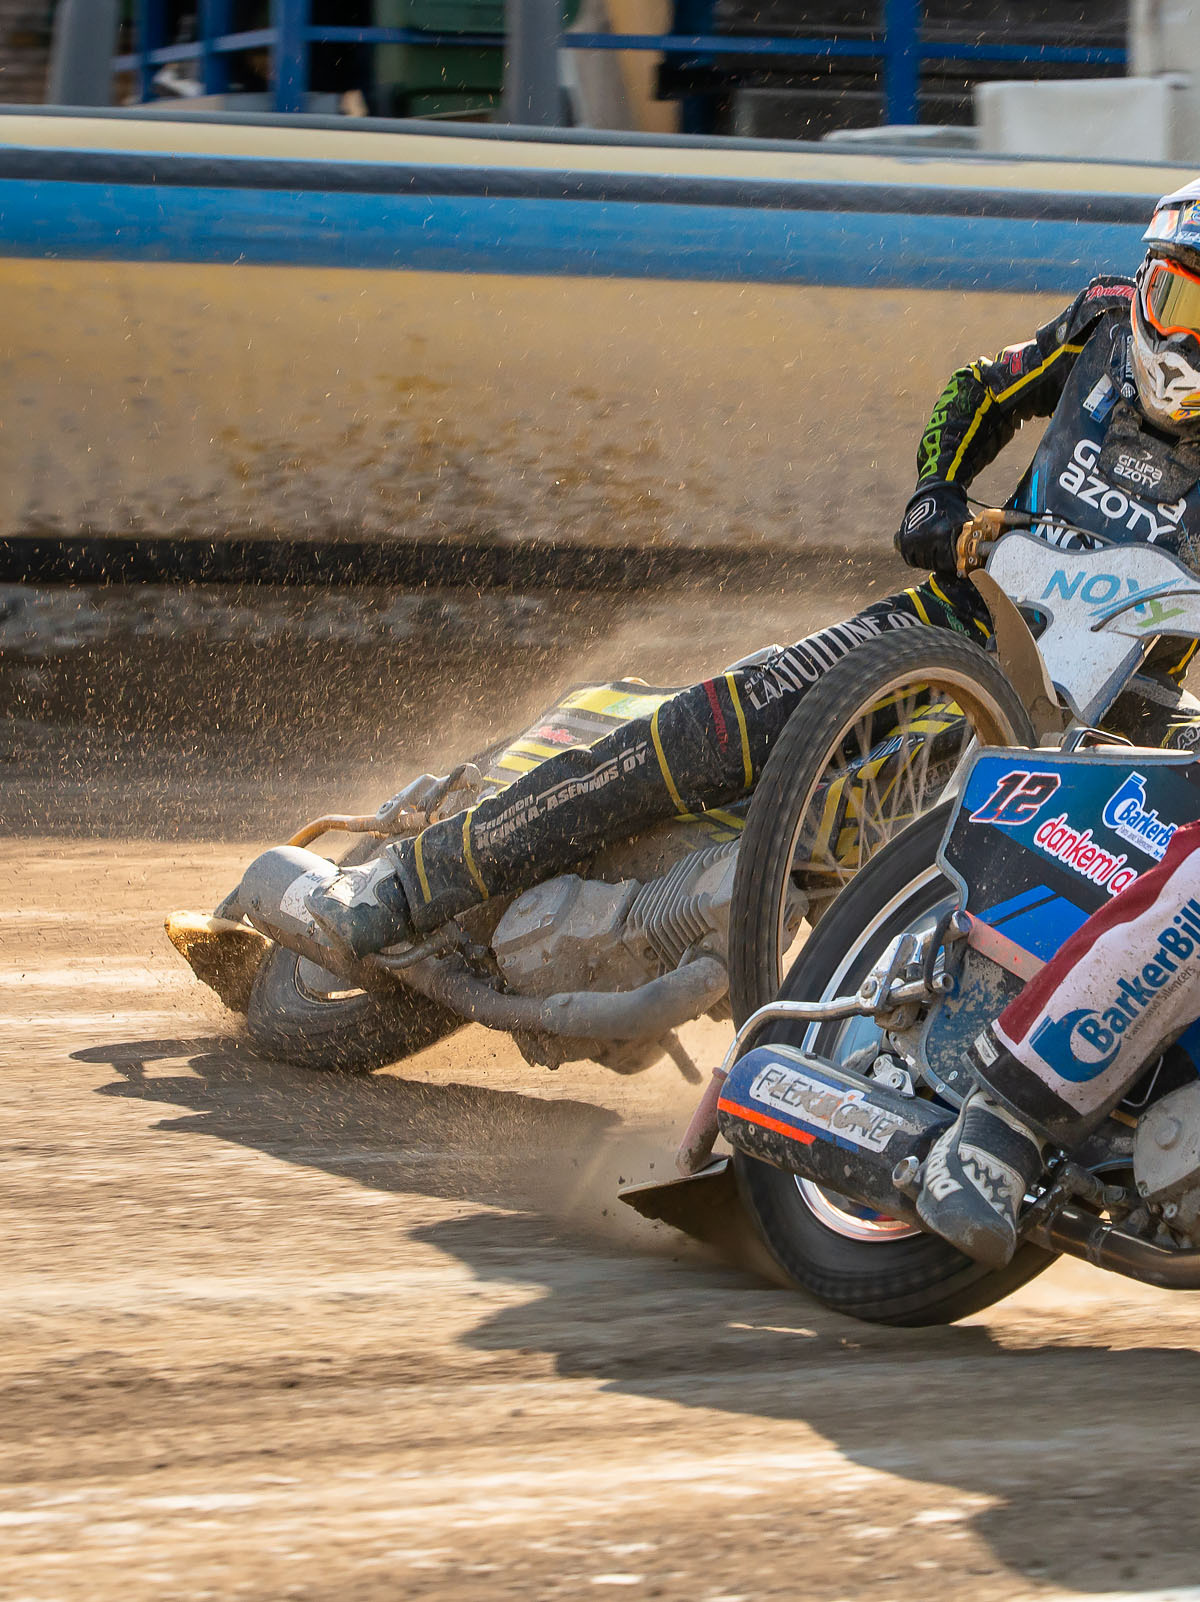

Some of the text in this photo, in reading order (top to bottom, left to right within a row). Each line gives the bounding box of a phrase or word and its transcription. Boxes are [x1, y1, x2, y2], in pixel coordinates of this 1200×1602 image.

[969, 770, 1061, 825] 12
[1117, 799, 1176, 850] BarkerB
[1035, 815, 1127, 884] dankemi
